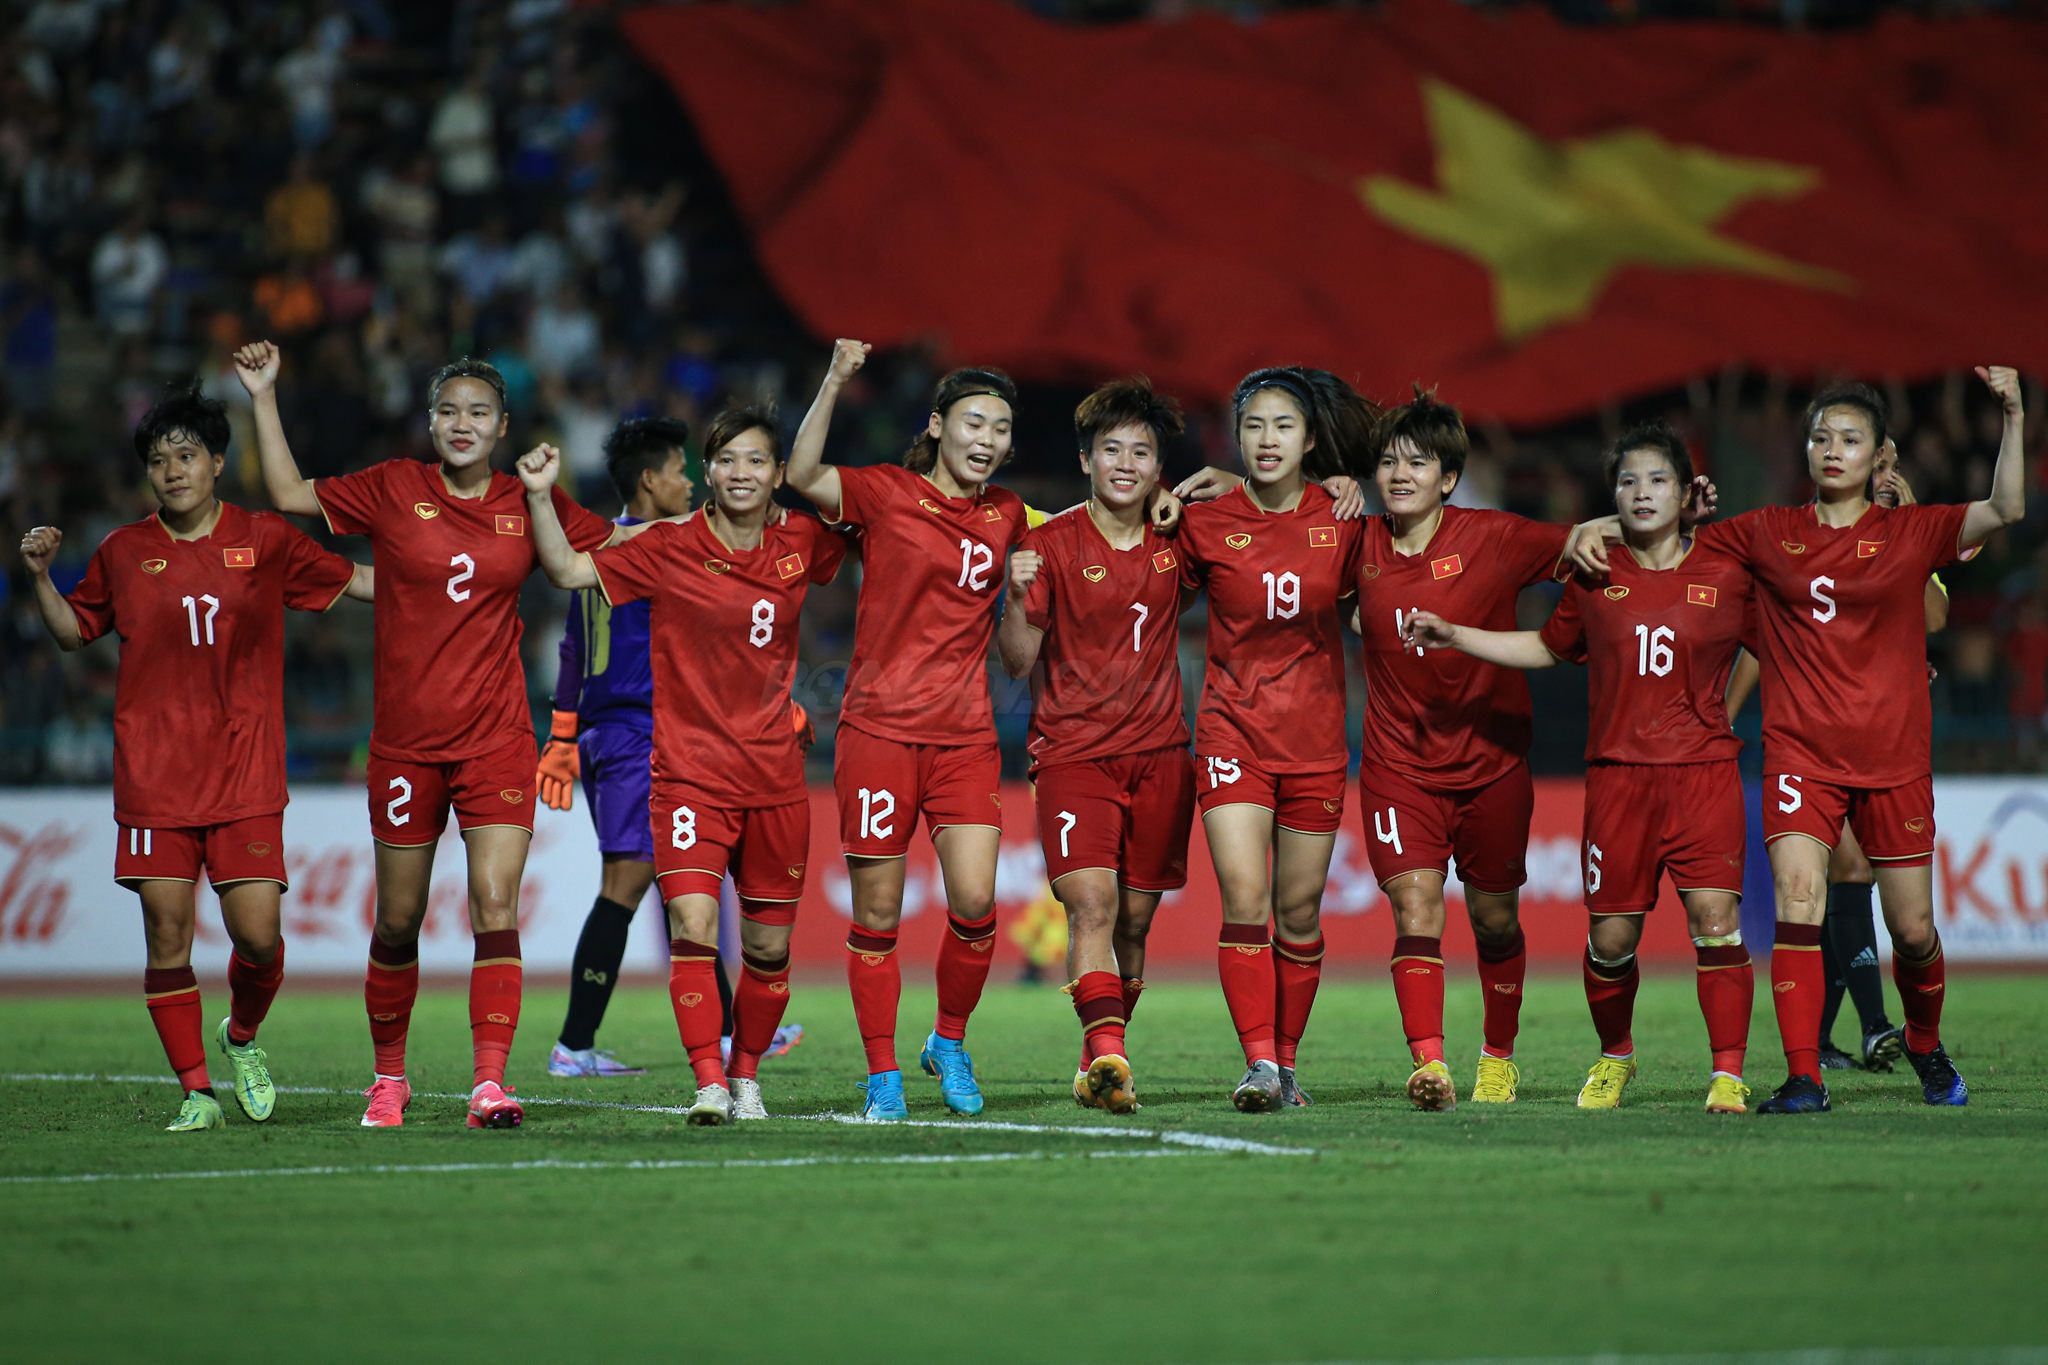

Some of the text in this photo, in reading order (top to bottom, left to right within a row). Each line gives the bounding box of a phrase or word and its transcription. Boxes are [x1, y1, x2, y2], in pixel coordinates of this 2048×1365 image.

[446, 552, 475, 603] 2
[957, 538, 993, 592] 12
[181, 593, 220, 647] 17
[1262, 570, 1301, 621] 19
[1810, 575, 1837, 624] 5
[749, 598, 775, 649] 8
[1129, 601, 1149, 653] 7
[1635, 623, 1675, 678] 16
[387, 775, 412, 827] 2
[857, 787, 895, 840] 12
[1778, 774, 1803, 815] 5
[671, 805, 697, 851] 8
[1055, 810, 1076, 858] 7
[1374, 806, 1404, 855] 4
